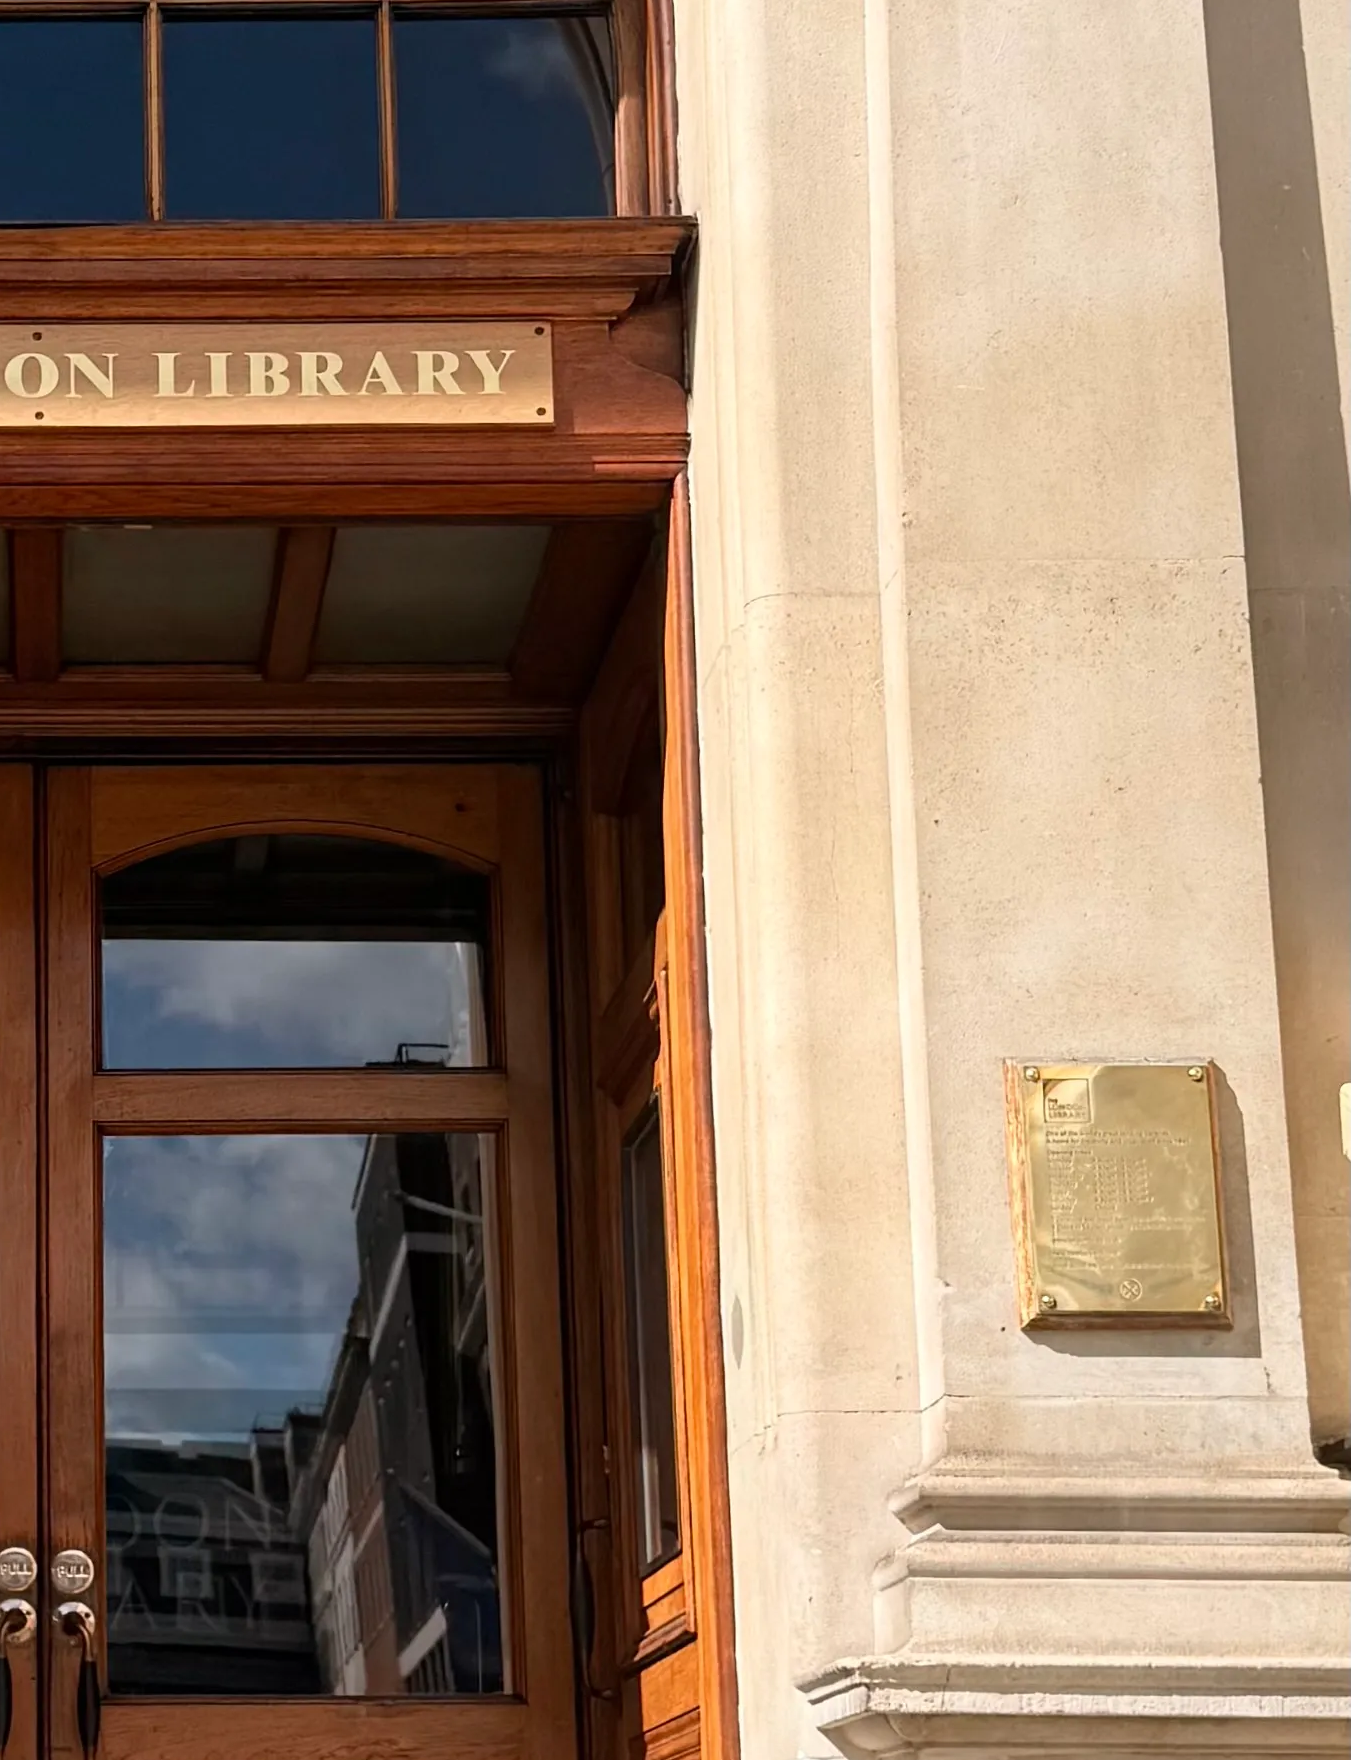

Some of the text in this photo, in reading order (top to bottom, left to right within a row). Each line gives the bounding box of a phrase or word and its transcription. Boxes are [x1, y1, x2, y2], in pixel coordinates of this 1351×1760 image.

[151, 349, 516, 398] LIBRARY
[0, 1563, 32, 1576] PULL
[56, 1565, 90, 1578] PULL
